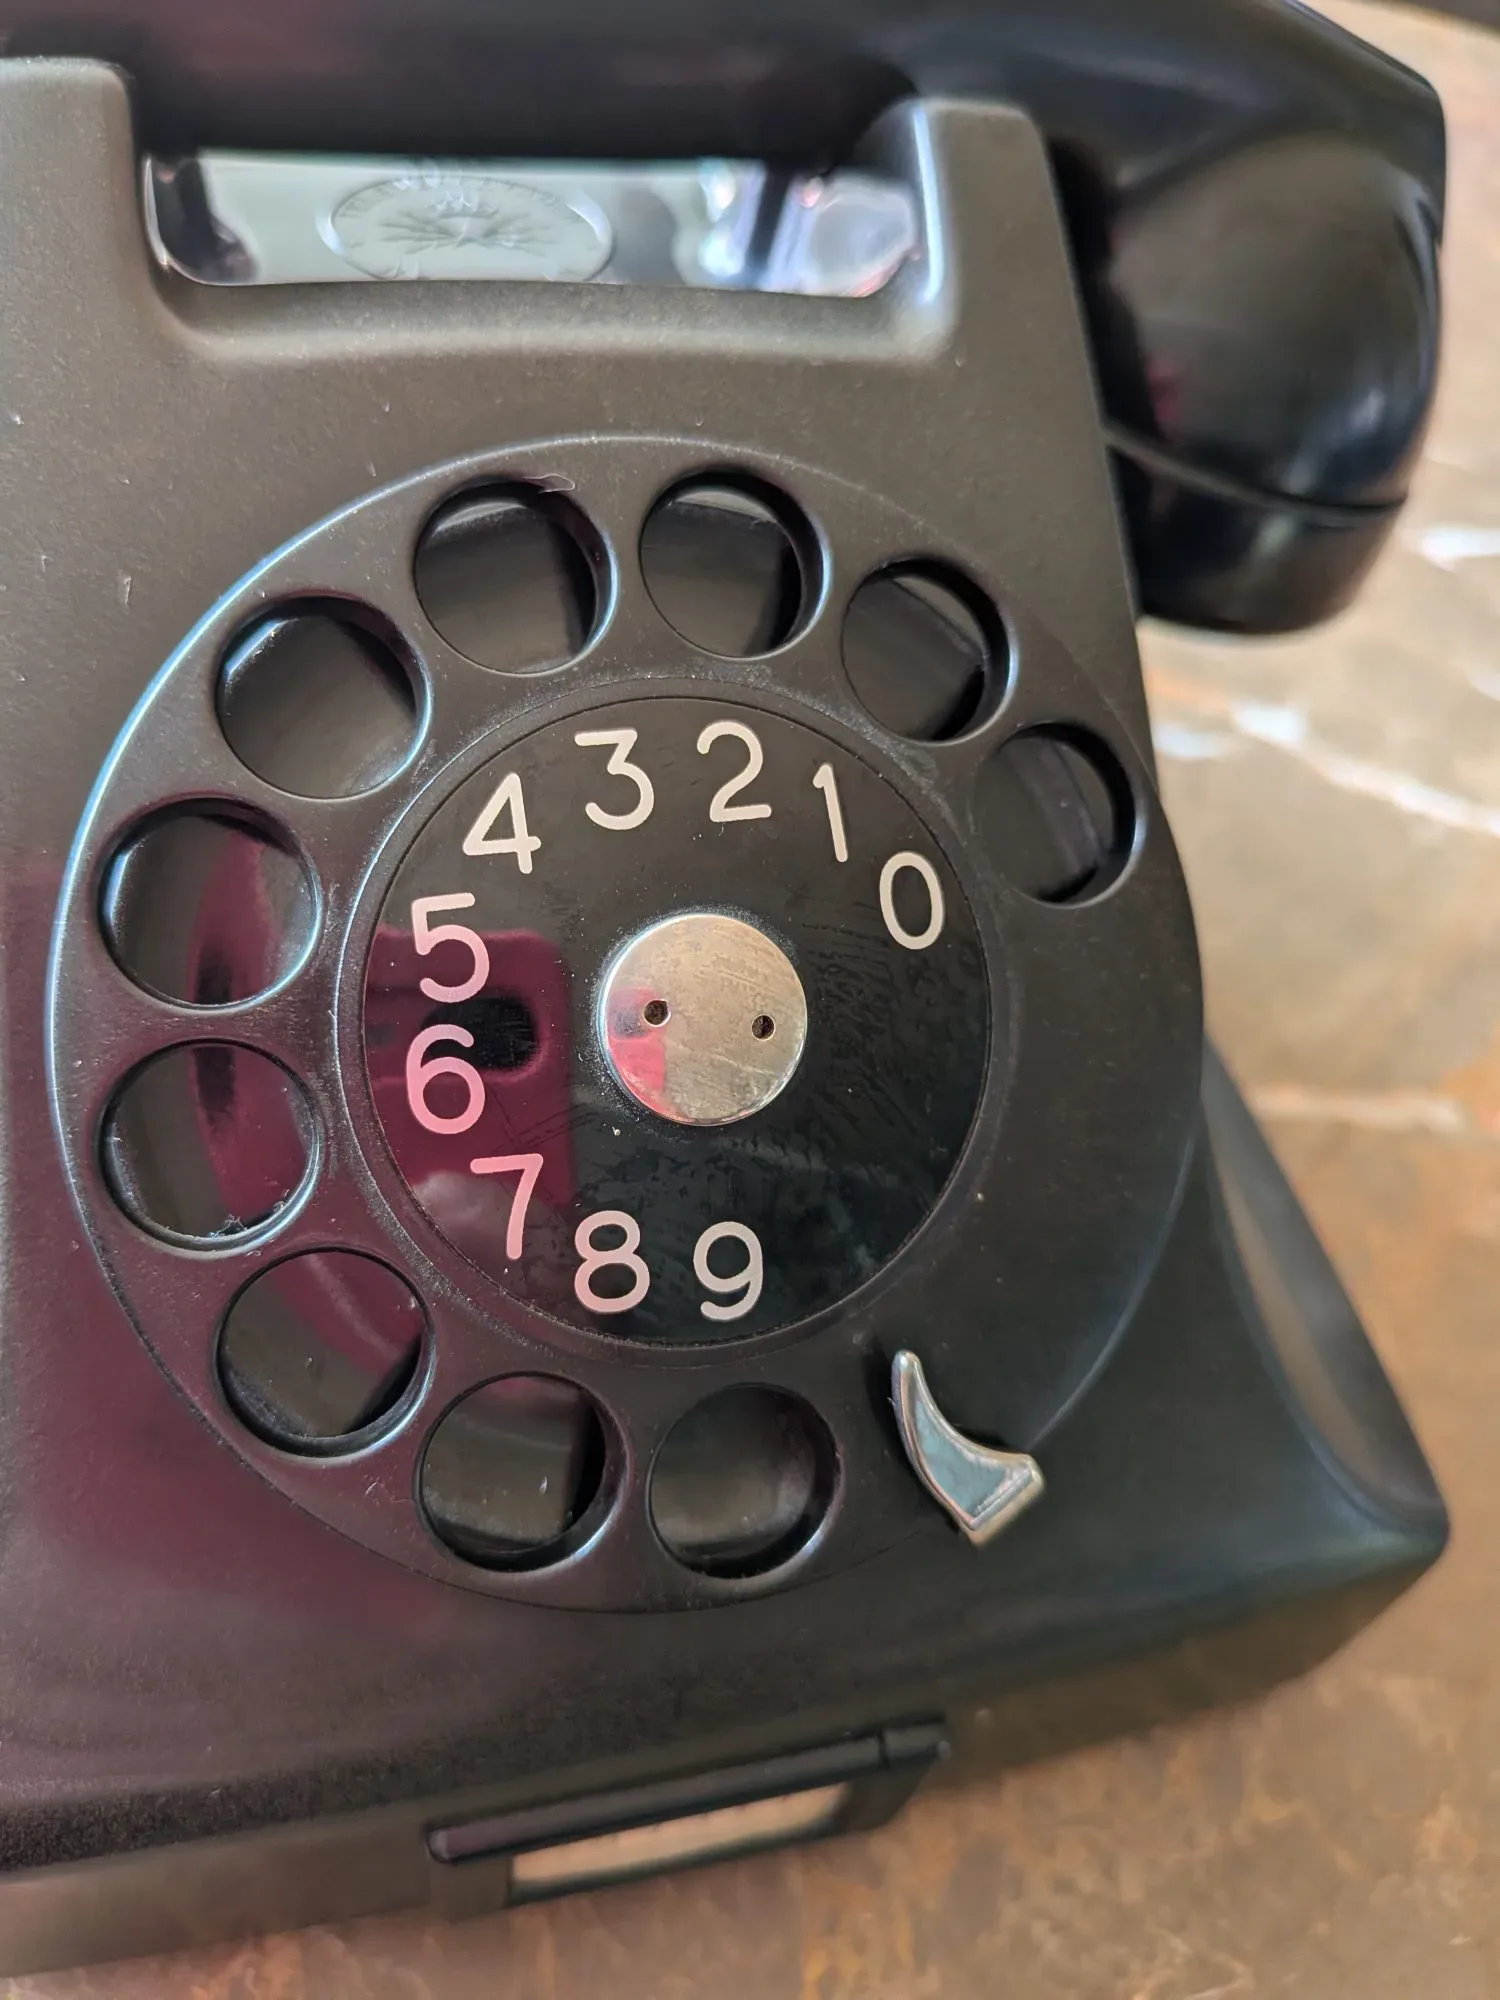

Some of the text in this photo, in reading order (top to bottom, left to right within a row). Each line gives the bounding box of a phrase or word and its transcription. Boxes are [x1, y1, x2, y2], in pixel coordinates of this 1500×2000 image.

[462, 771, 542, 875] 4
[575, 728, 655, 831] 3
[697, 719, 772, 823] 2
[813, 762, 849, 863] 1
[410, 892, 490, 1003] 5
[879, 851, 945, 950] 0
[406, 1024, 485, 1135] 6
[470, 1153, 544, 1260] 7
[574, 1210, 650, 1314] 8
[693, 1221, 764, 1321] 9
